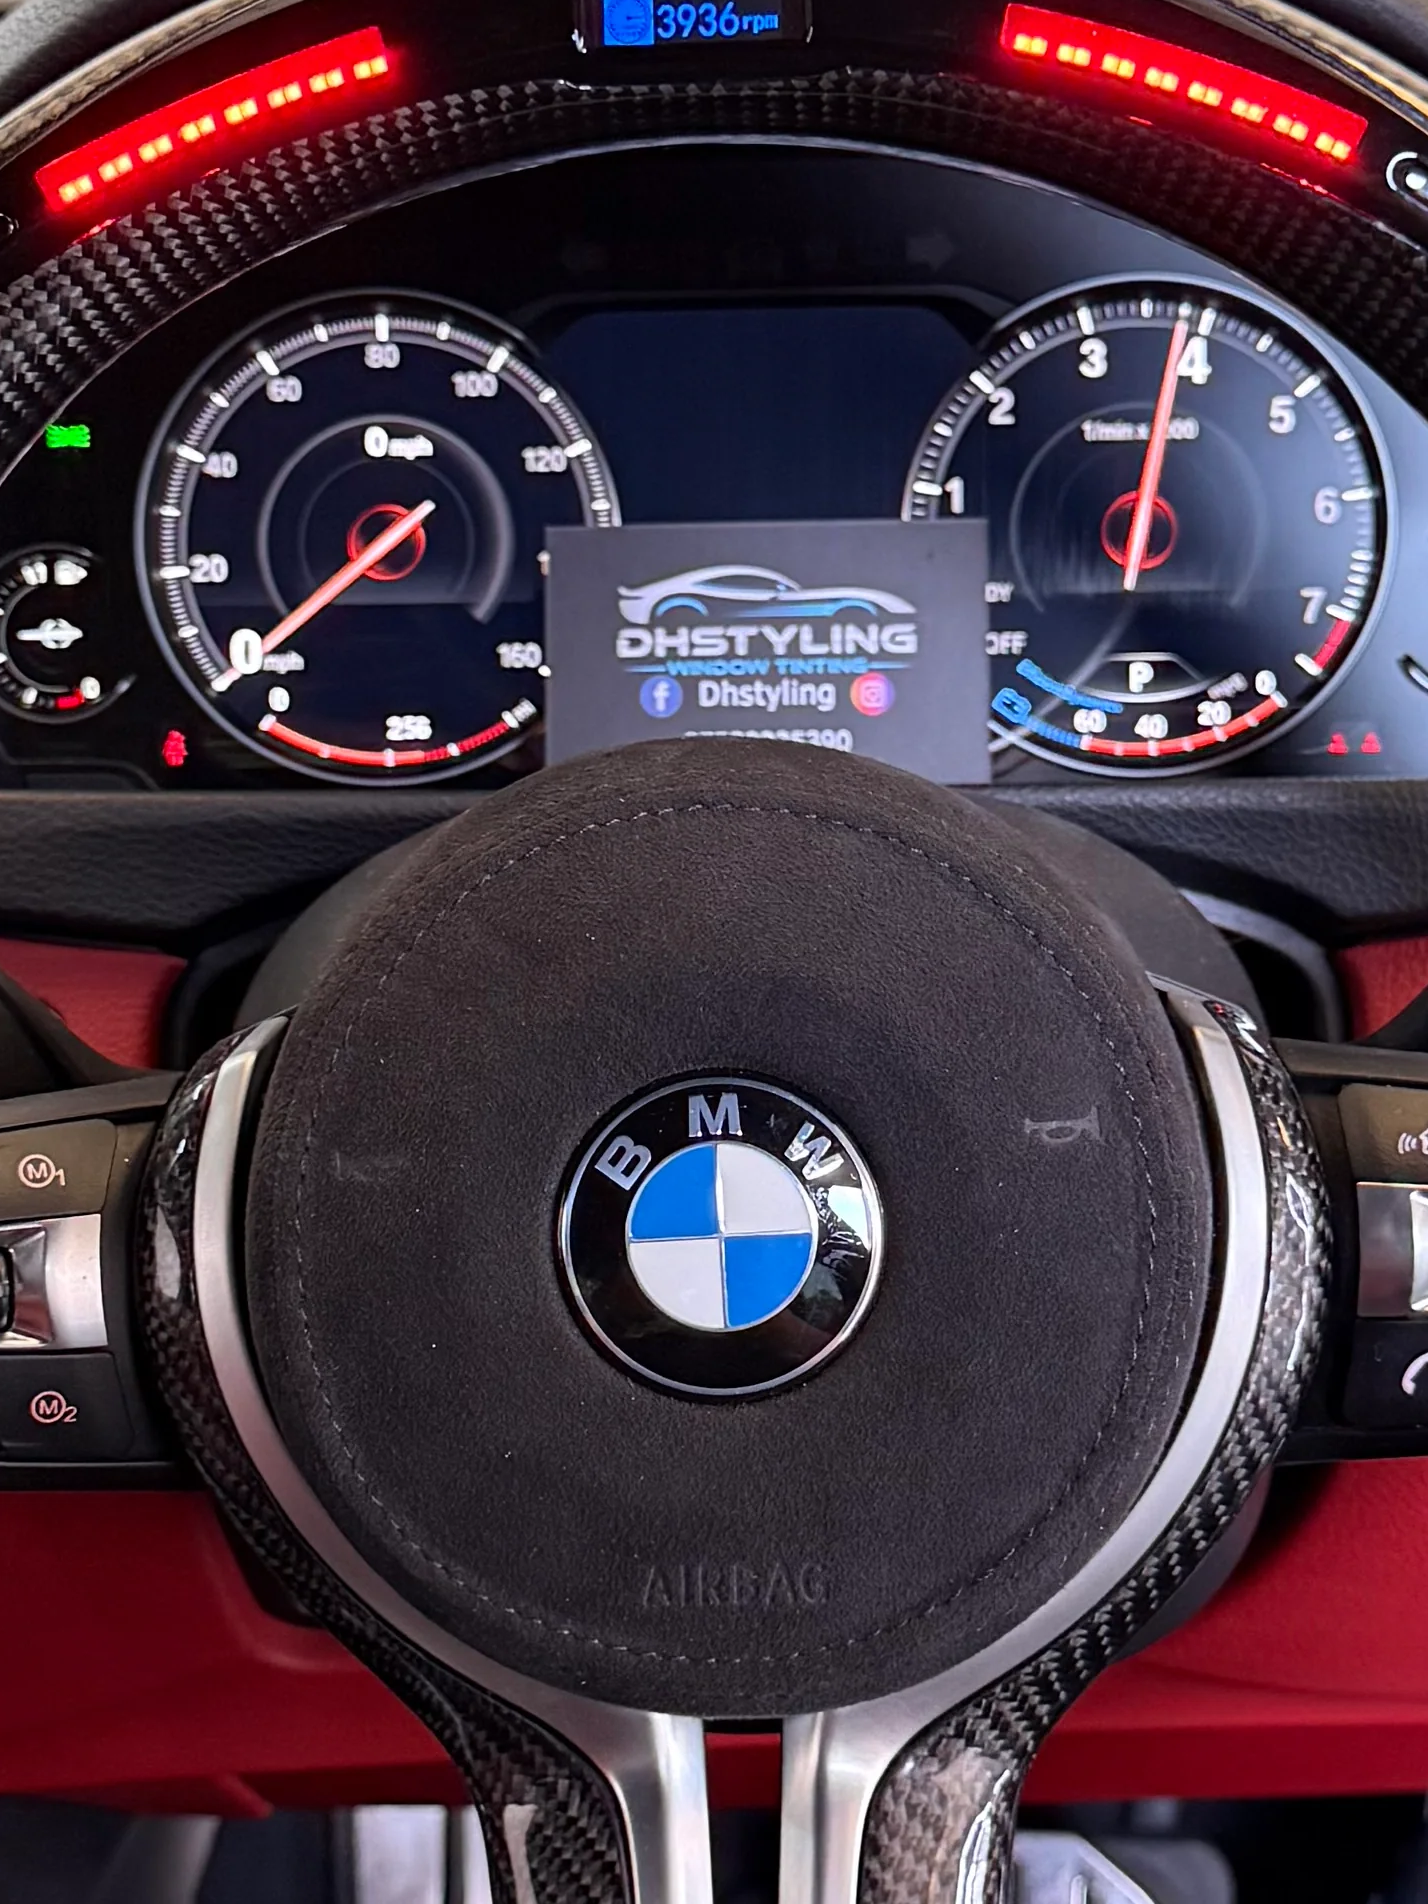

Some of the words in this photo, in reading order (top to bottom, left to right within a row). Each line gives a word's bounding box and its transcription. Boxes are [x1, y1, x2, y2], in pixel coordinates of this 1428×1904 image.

[656, 1, 740, 39] 3936
[741, 12, 779, 34] rpm
[365, 342, 400, 369] 80
[1079, 339, 1108, 377] 3
[1177, 337, 1212, 385] 4
[266, 374, 303, 402] 60
[451, 370, 499, 398] 100
[987, 387, 1016, 425] 2
[1269, 395, 1296, 434] 5
[364, 425, 388, 457] 0
[203, 451, 238, 478] 40
[521, 445, 567, 473] 120
[942, 476, 965, 514] 1
[1313, 488, 1340, 524] 6
[189, 553, 229, 583] 20
[1300, 587, 1328, 624] 7
[229, 627, 264, 675] 0
[616, 622, 918, 658] DHSTYLING
[666, 658, 771, 677] WINDOW
[774, 656, 869, 676] TINTING
[1128, 661, 1154, 693] P
[697, 677, 837, 712] Dhstyling
[1134, 713, 1169, 739] 40
[1197, 700, 1232, 725] 20
[594, 1092, 845, 1192] BMW
[643, 1561, 825, 1608] AIRBAG
